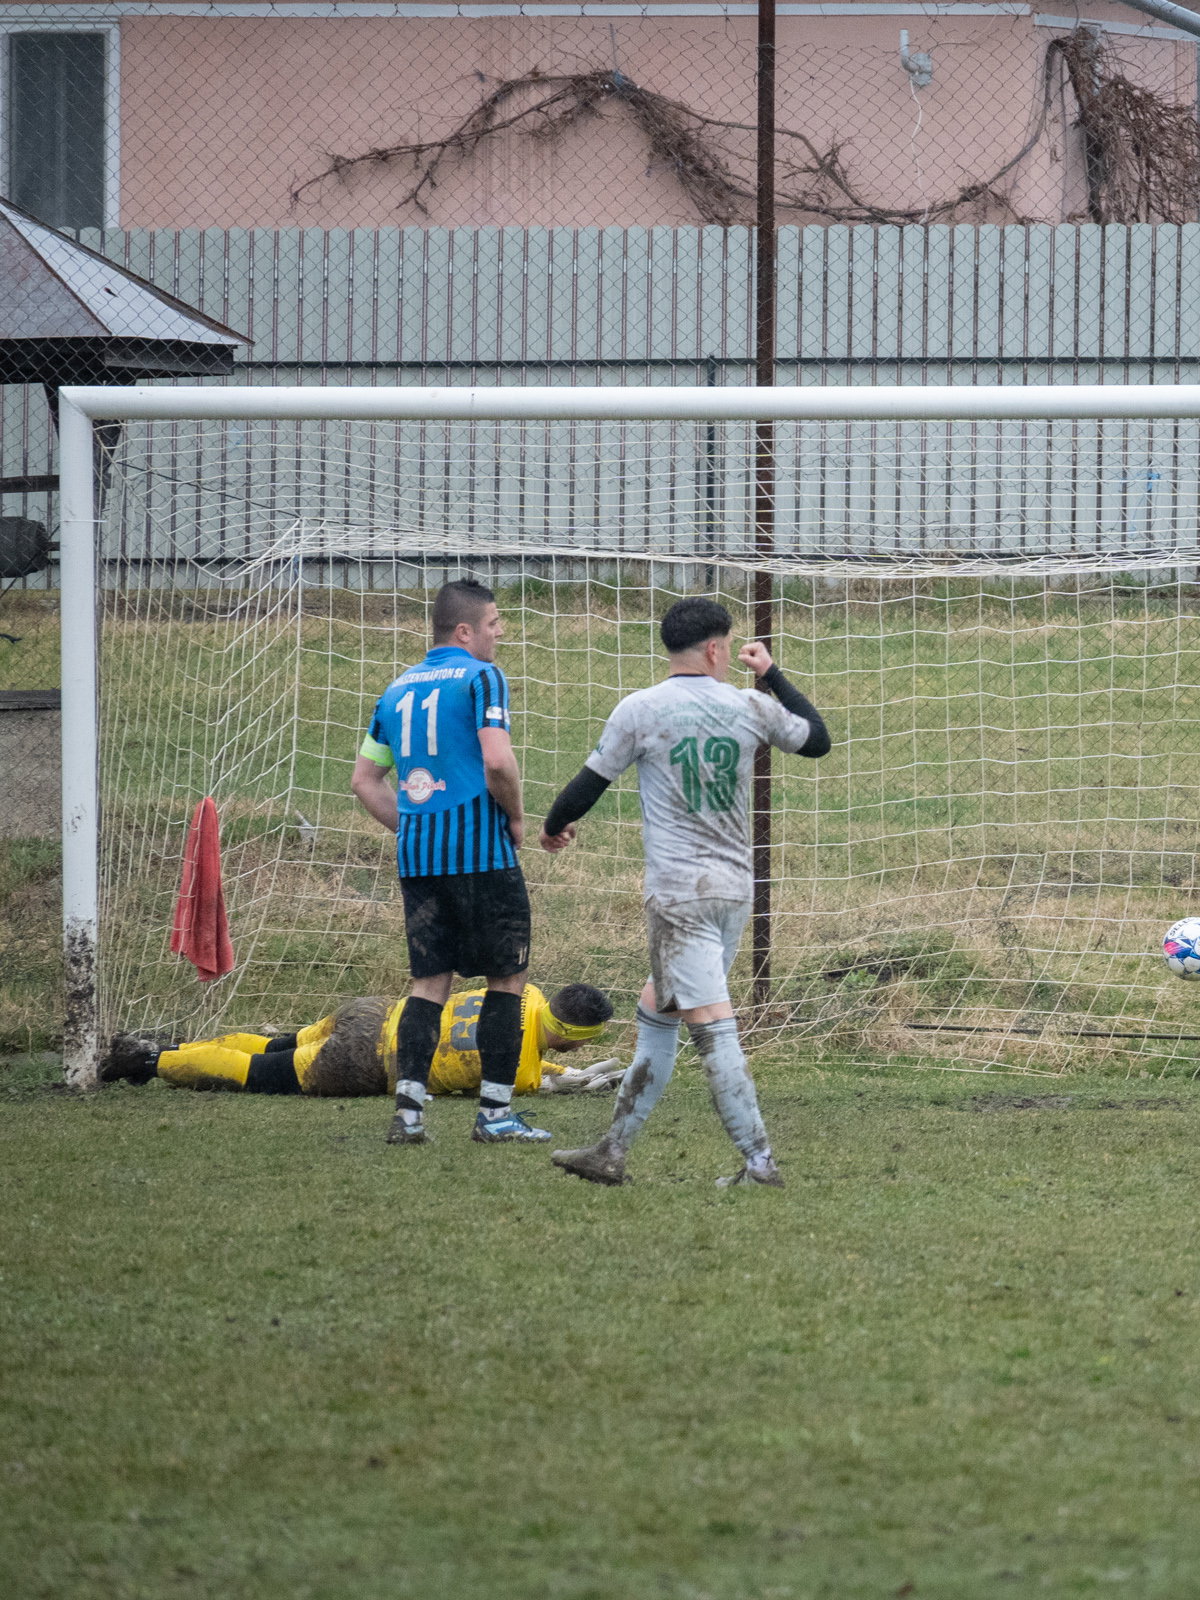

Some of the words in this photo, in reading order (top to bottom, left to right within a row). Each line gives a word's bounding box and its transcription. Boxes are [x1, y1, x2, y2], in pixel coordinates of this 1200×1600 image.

[453, 668, 468, 679] SE
[395, 688, 440, 758] 11
[669, 736, 741, 814] 13
